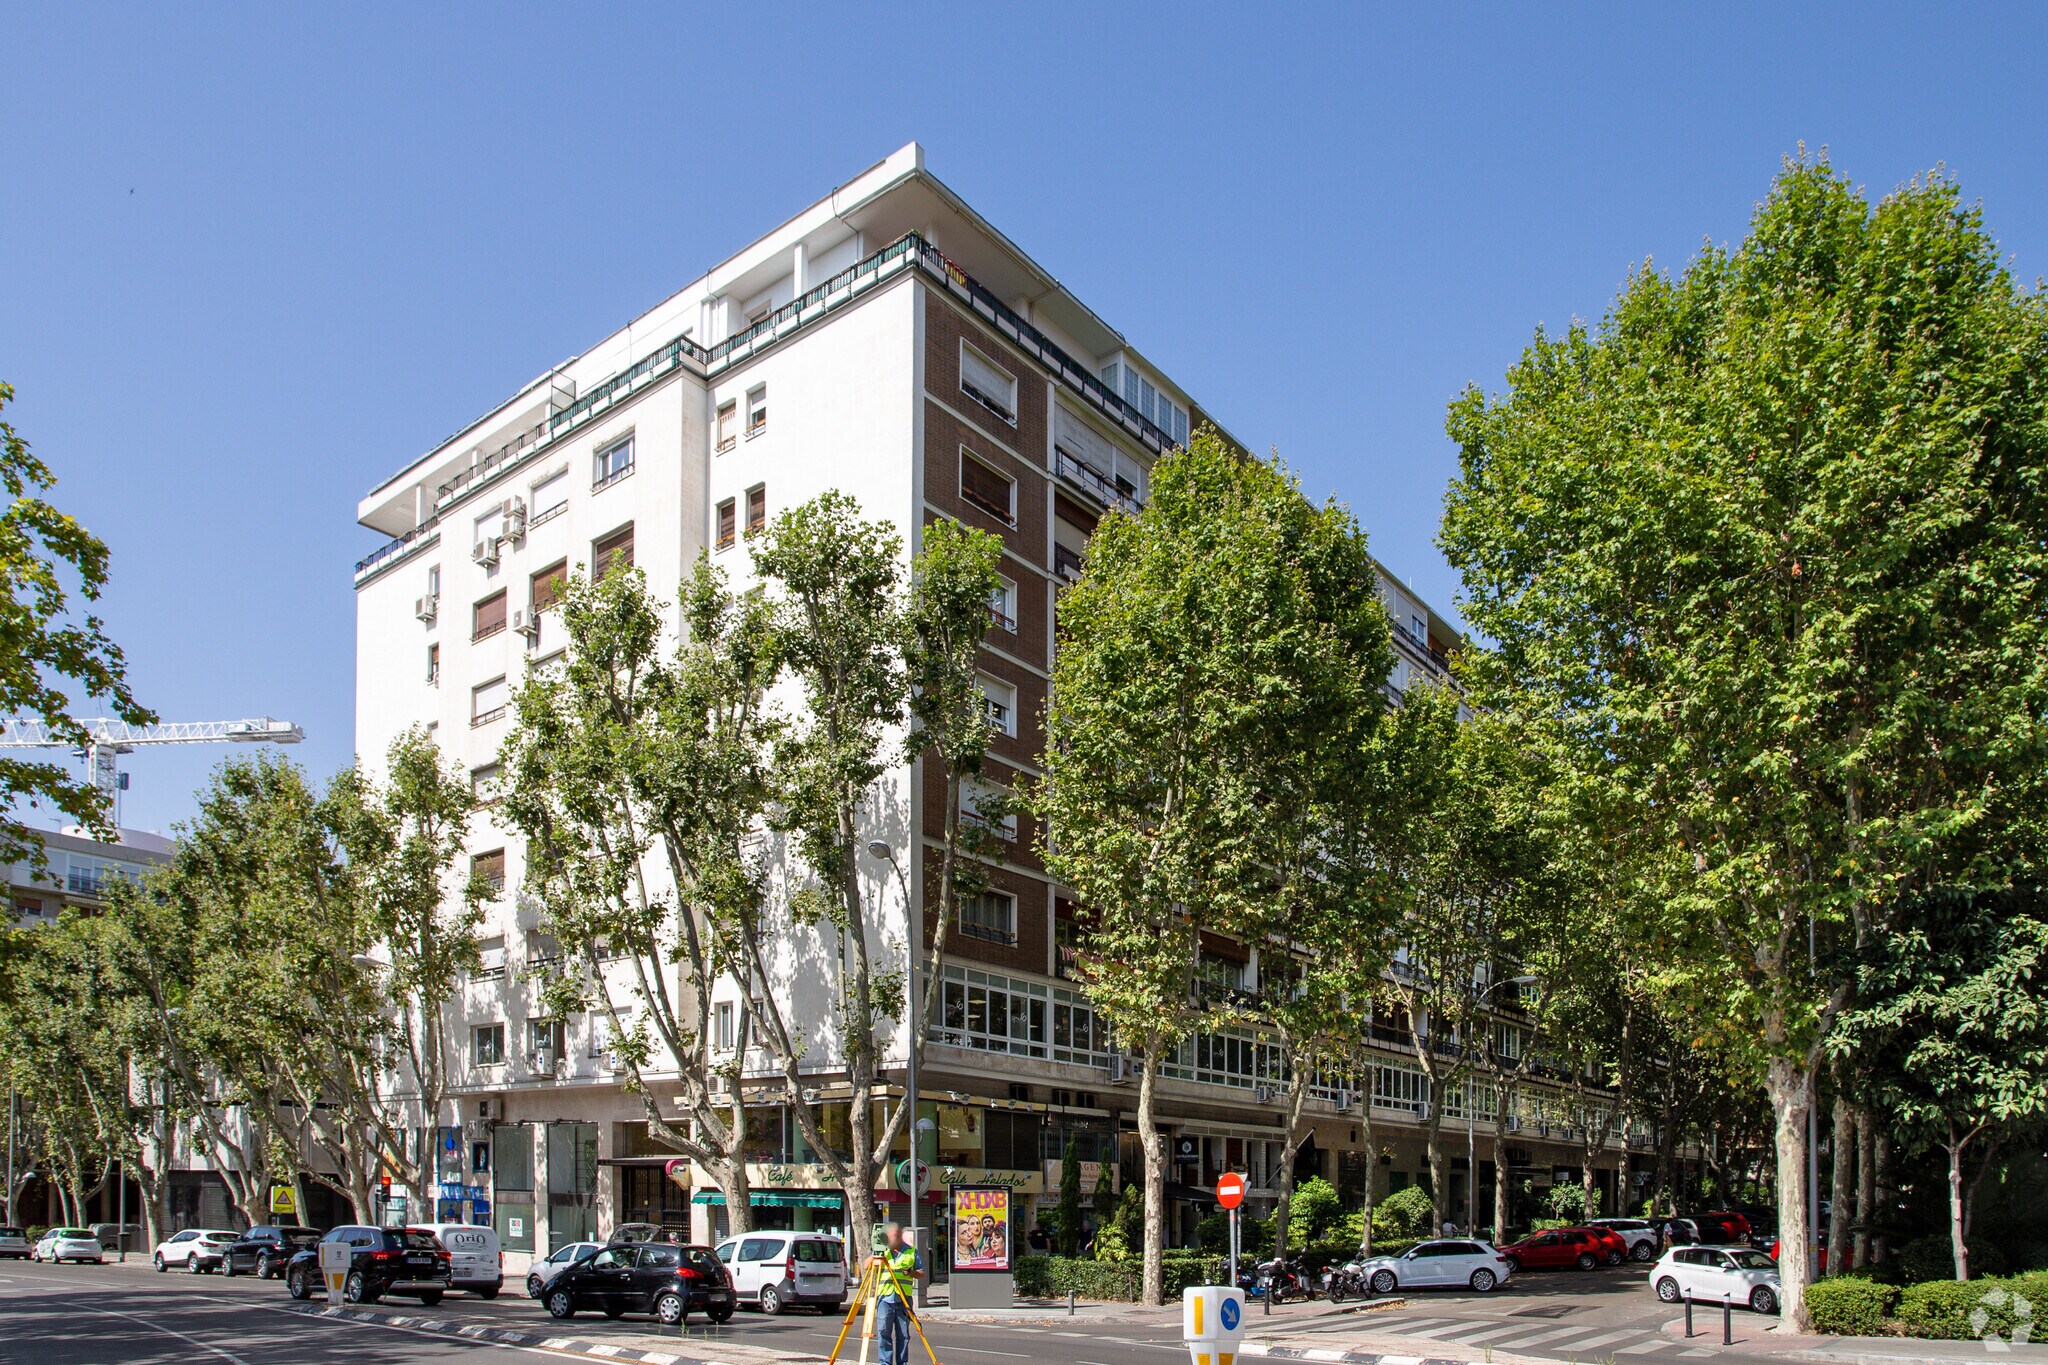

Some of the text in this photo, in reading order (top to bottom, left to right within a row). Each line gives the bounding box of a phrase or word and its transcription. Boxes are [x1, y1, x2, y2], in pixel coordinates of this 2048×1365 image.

[767, 1167, 793, 1186] Café
[976, 1172, 1027, 1187] Helados
[956, 1190, 1007, 1210] XHOXB
